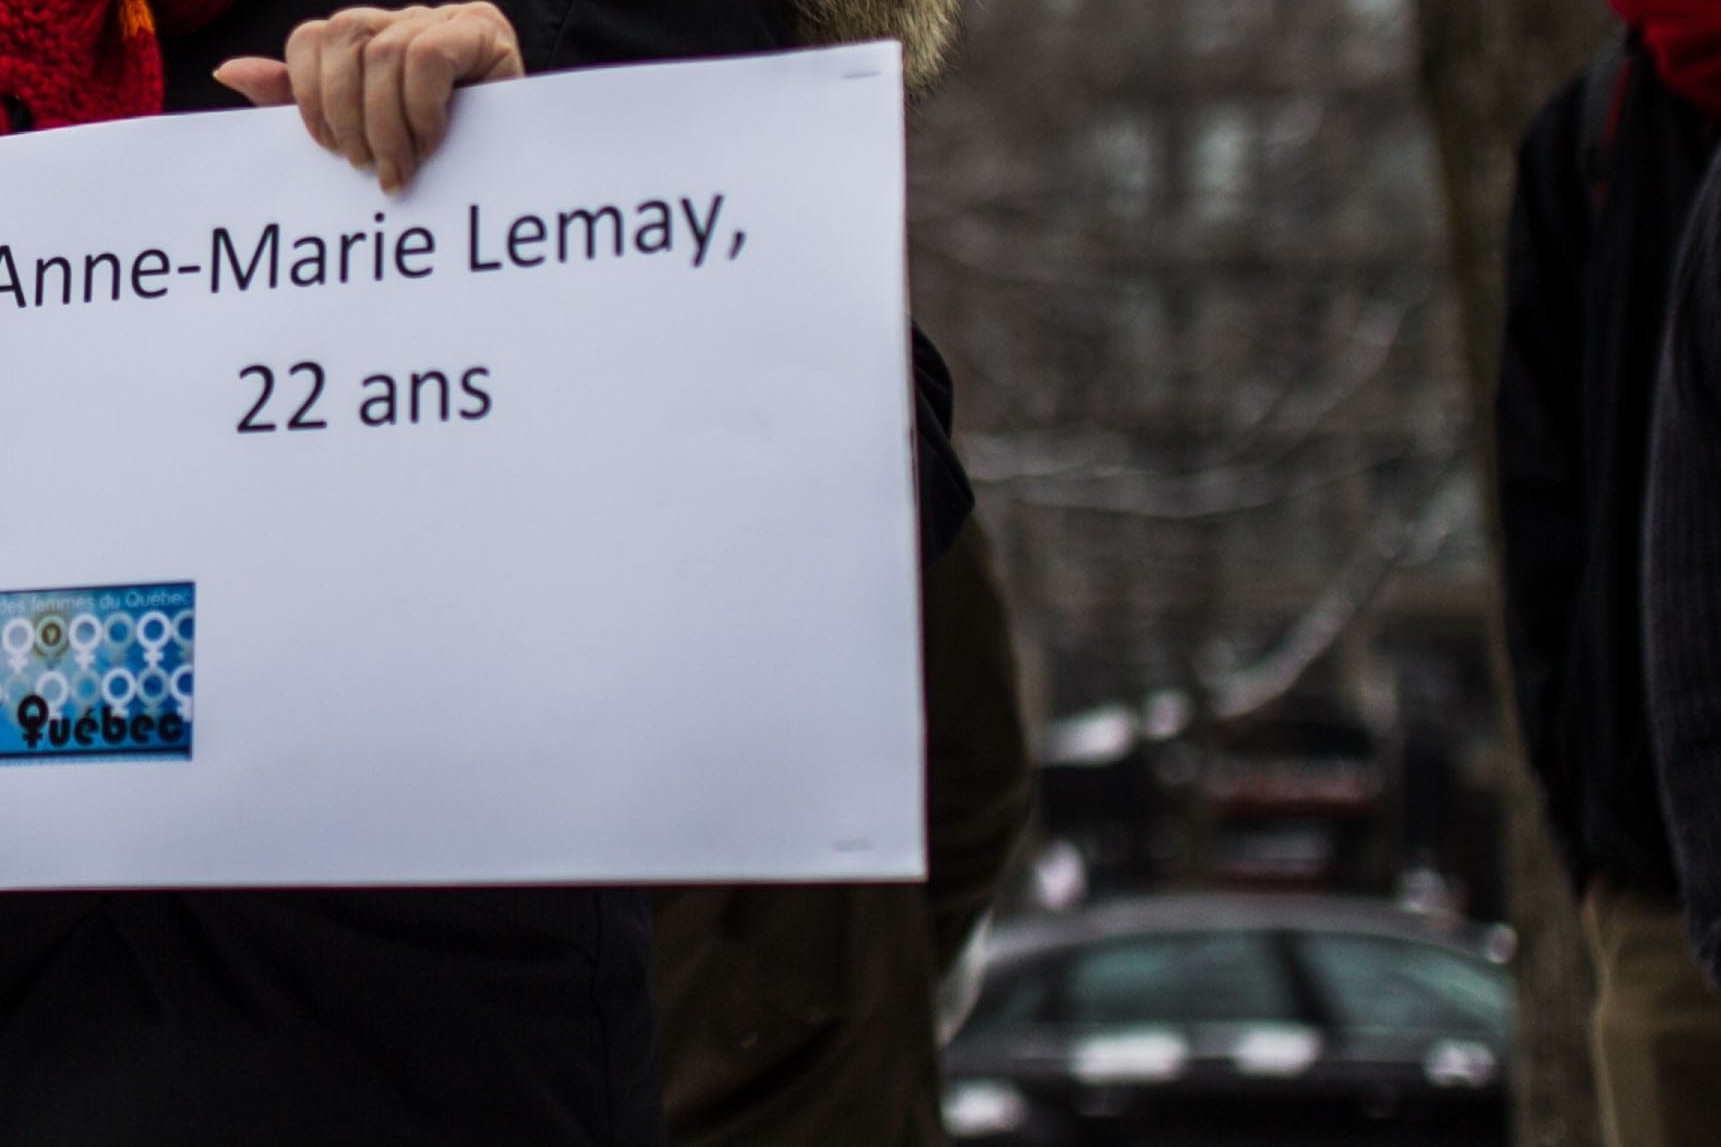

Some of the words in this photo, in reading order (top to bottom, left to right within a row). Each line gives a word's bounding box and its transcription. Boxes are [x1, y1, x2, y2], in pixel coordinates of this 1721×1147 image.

[469, 194, 746, 273] Lemay,
[236, 361, 328, 434] 22
[359, 366, 492, 427] ans
[99, 592, 121, 611] du
[17, 695, 186, 749] Québec
